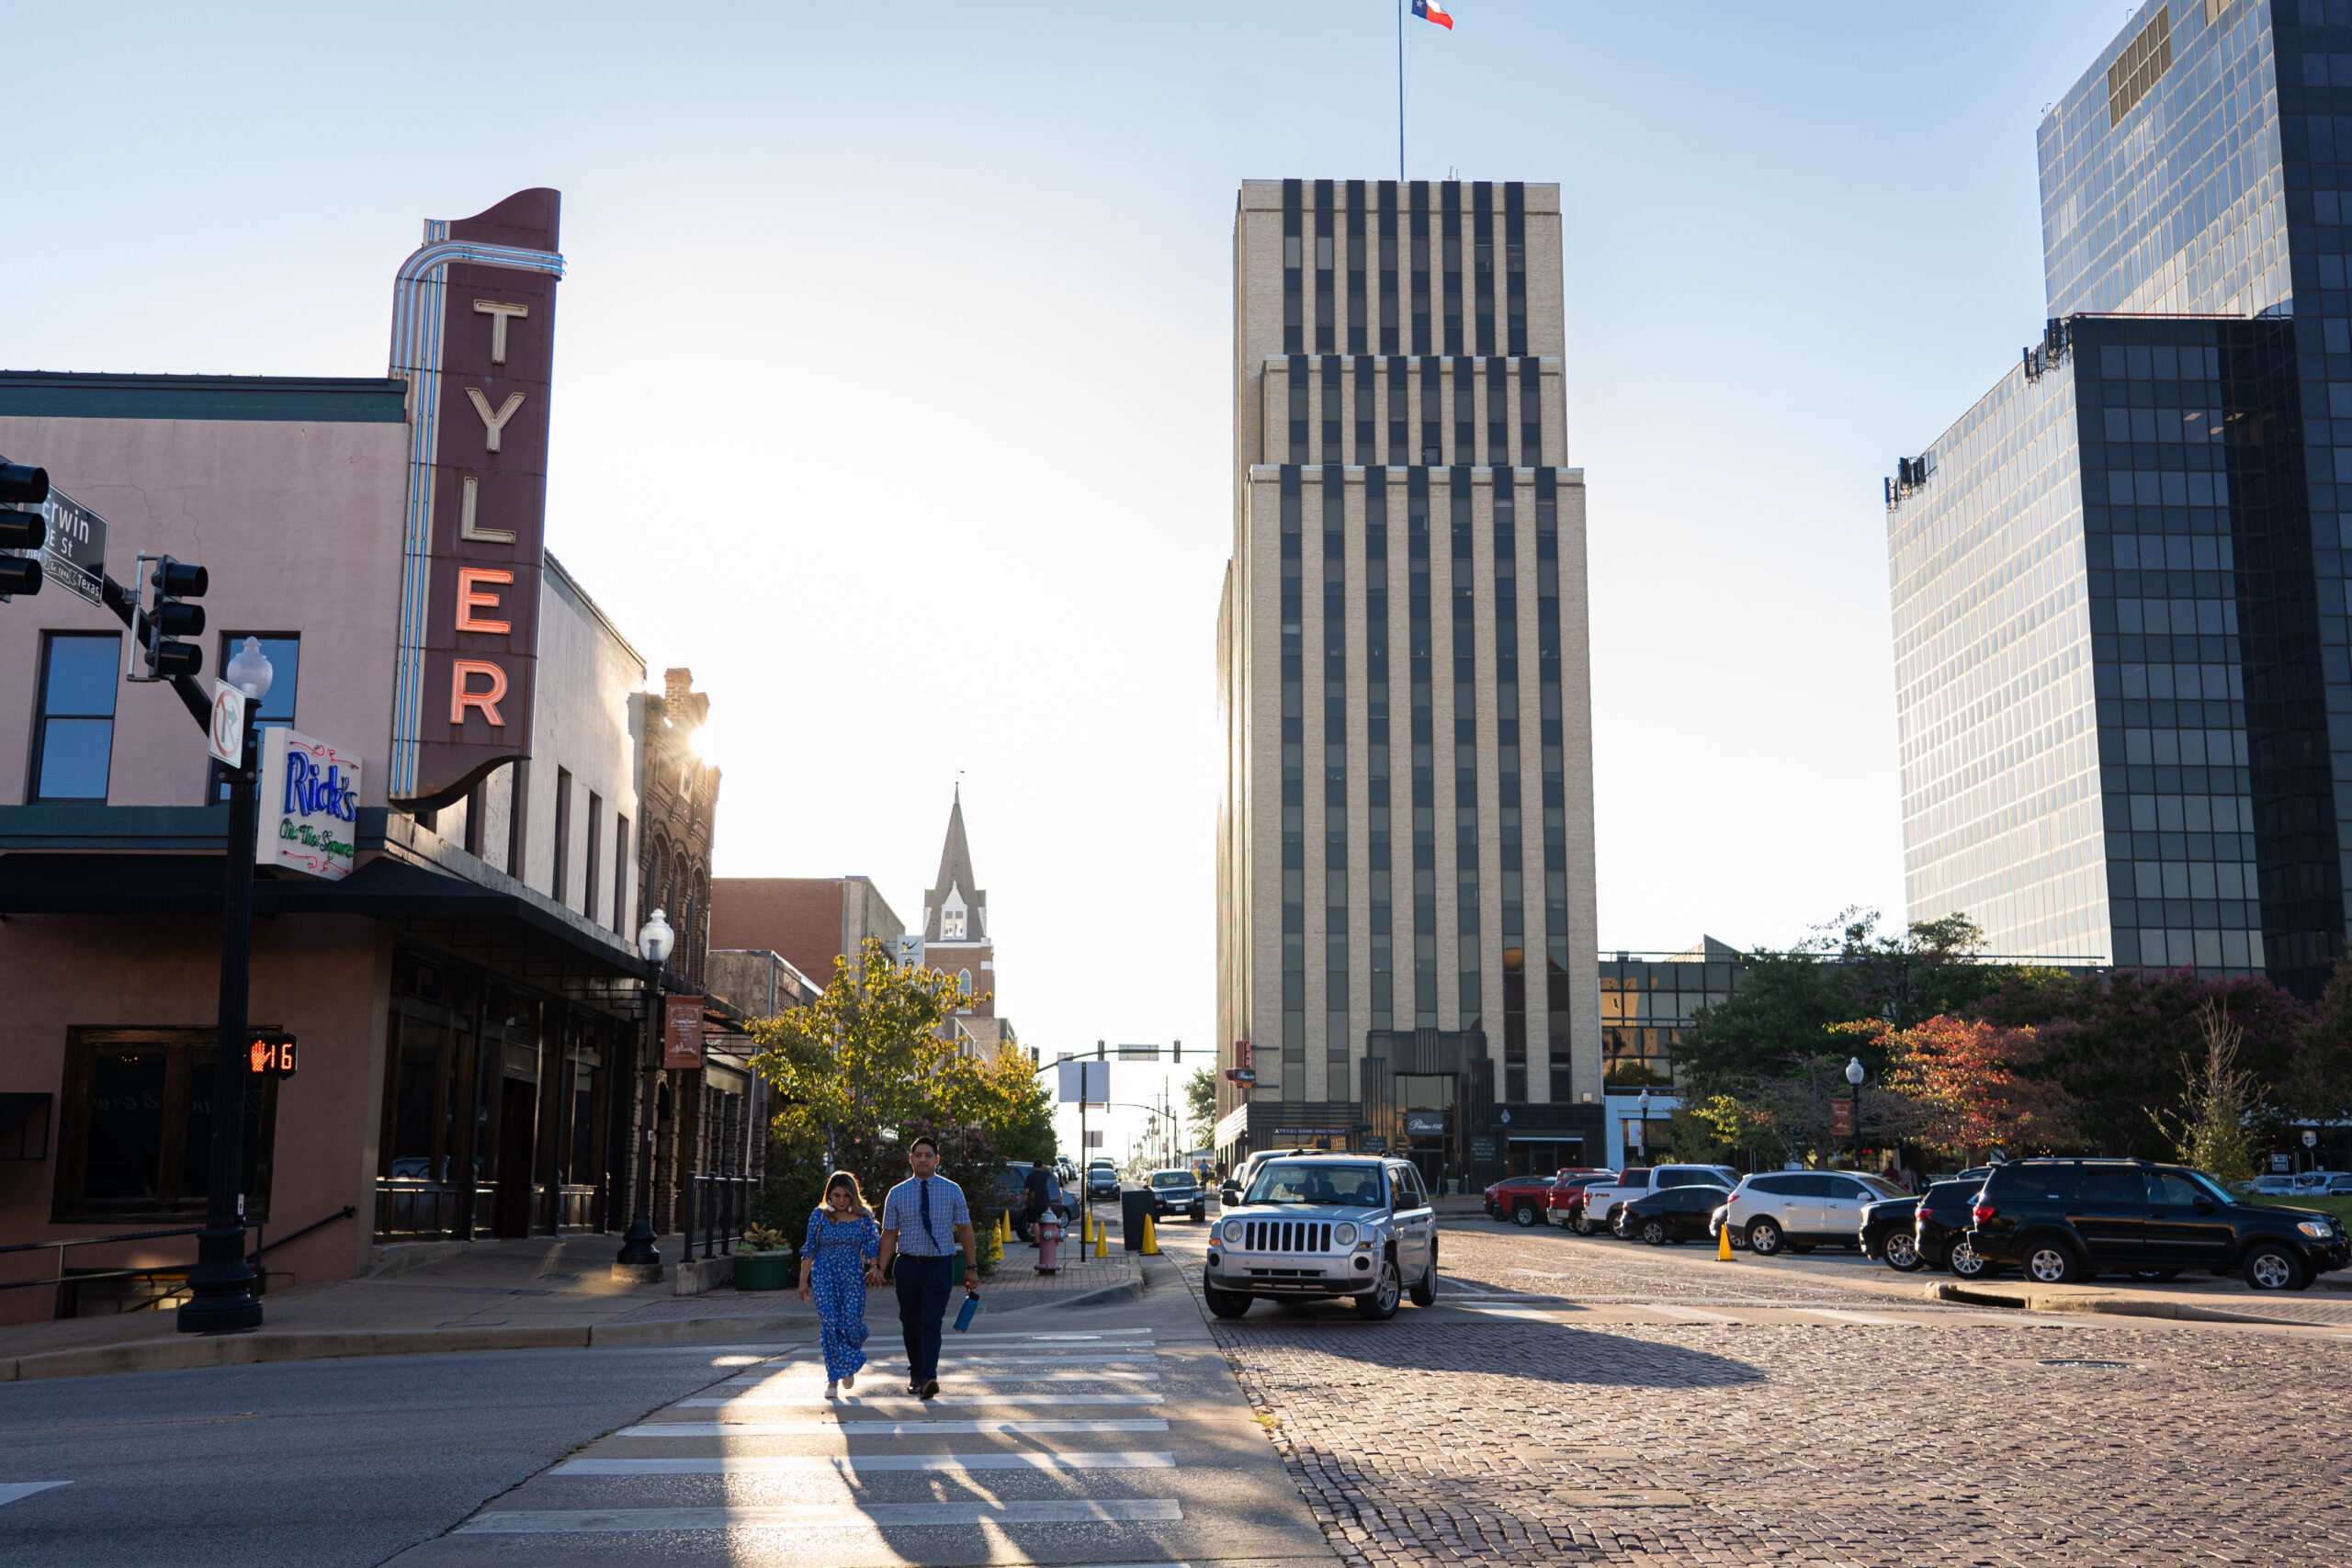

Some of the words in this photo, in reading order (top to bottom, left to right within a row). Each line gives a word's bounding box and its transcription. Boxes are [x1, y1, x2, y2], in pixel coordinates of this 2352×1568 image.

[41, 493, 90, 545] Erwin
[450, 299, 529, 728] TYLER
[61, 536, 74, 558] St
[77, 573, 100, 597] Texas
[284, 751, 358, 822] Rick's
[300, 824, 321, 847] The
[320, 829, 357, 861] Square
[270, 1043, 293, 1070] 16
